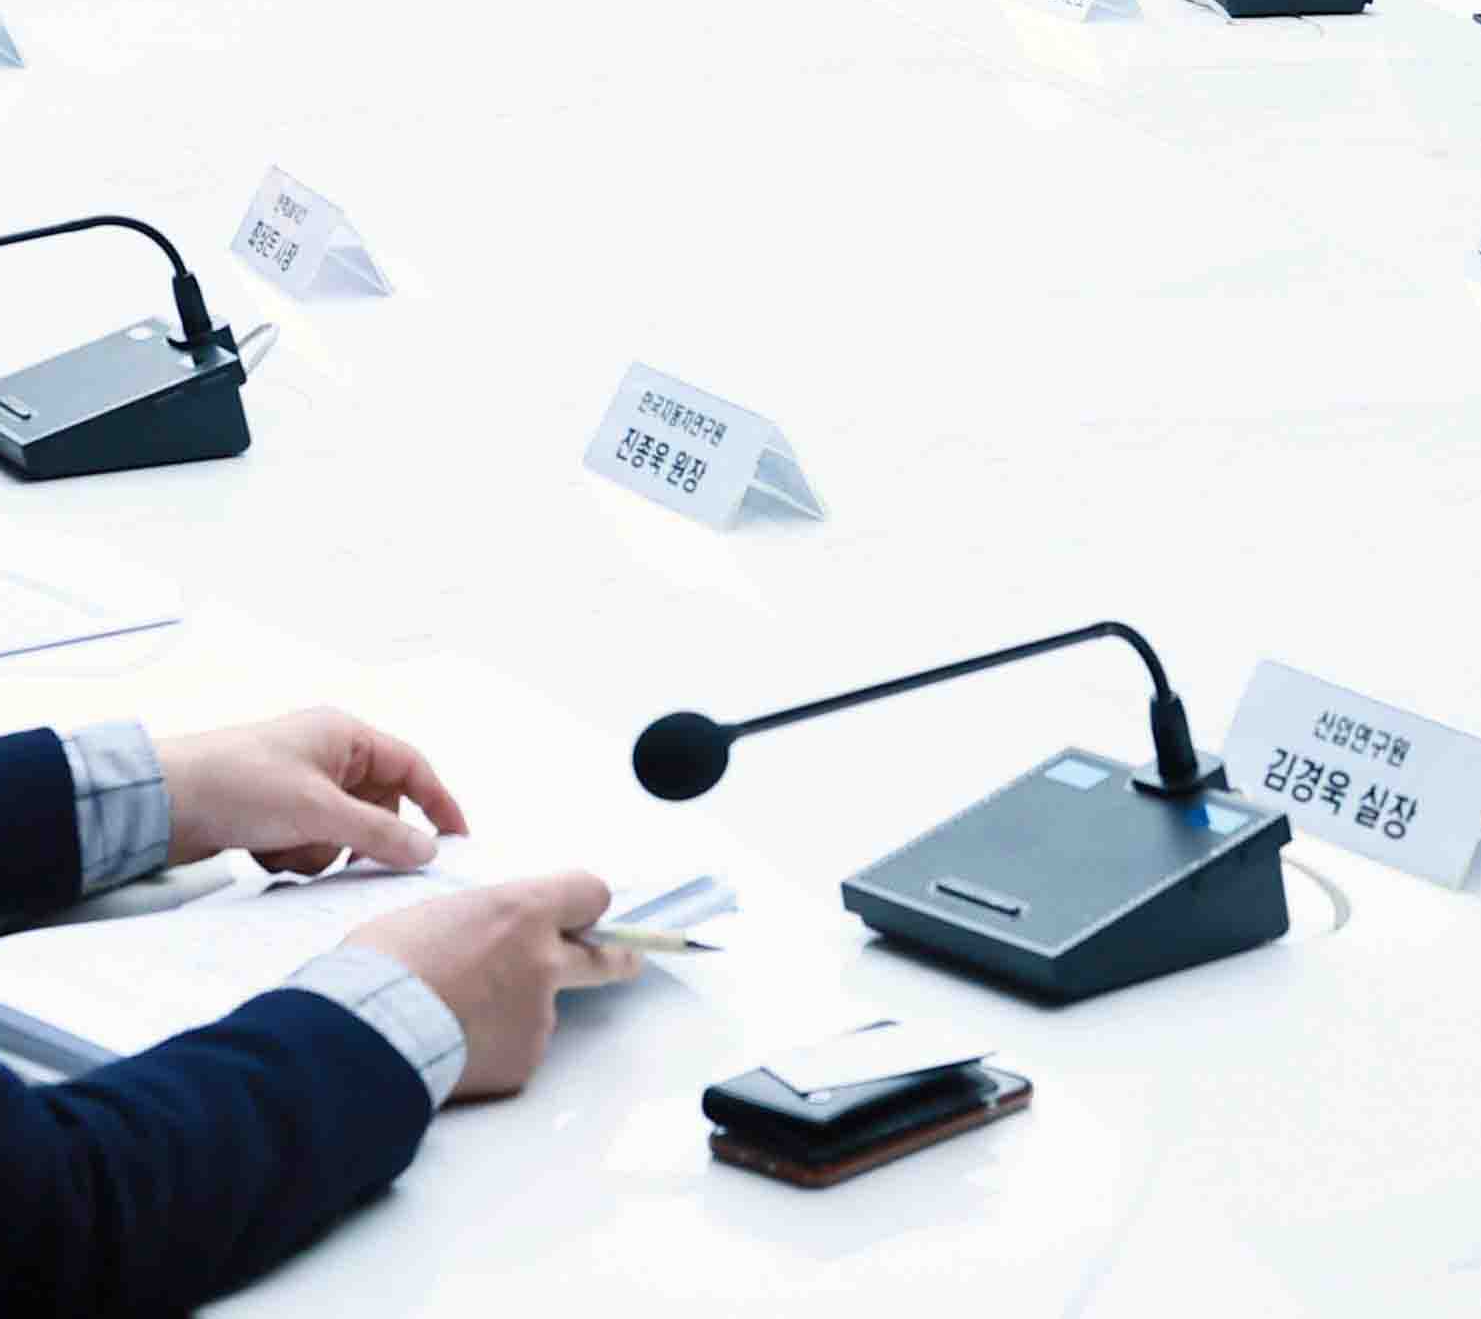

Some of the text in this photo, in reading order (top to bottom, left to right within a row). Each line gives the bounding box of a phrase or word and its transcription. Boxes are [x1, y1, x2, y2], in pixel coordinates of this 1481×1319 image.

[615, 427, 707, 494] 진종욱 원장
[1313, 709, 1411, 768] 산업연구원
[1263, 747, 1417, 841] 김경욱 실장
